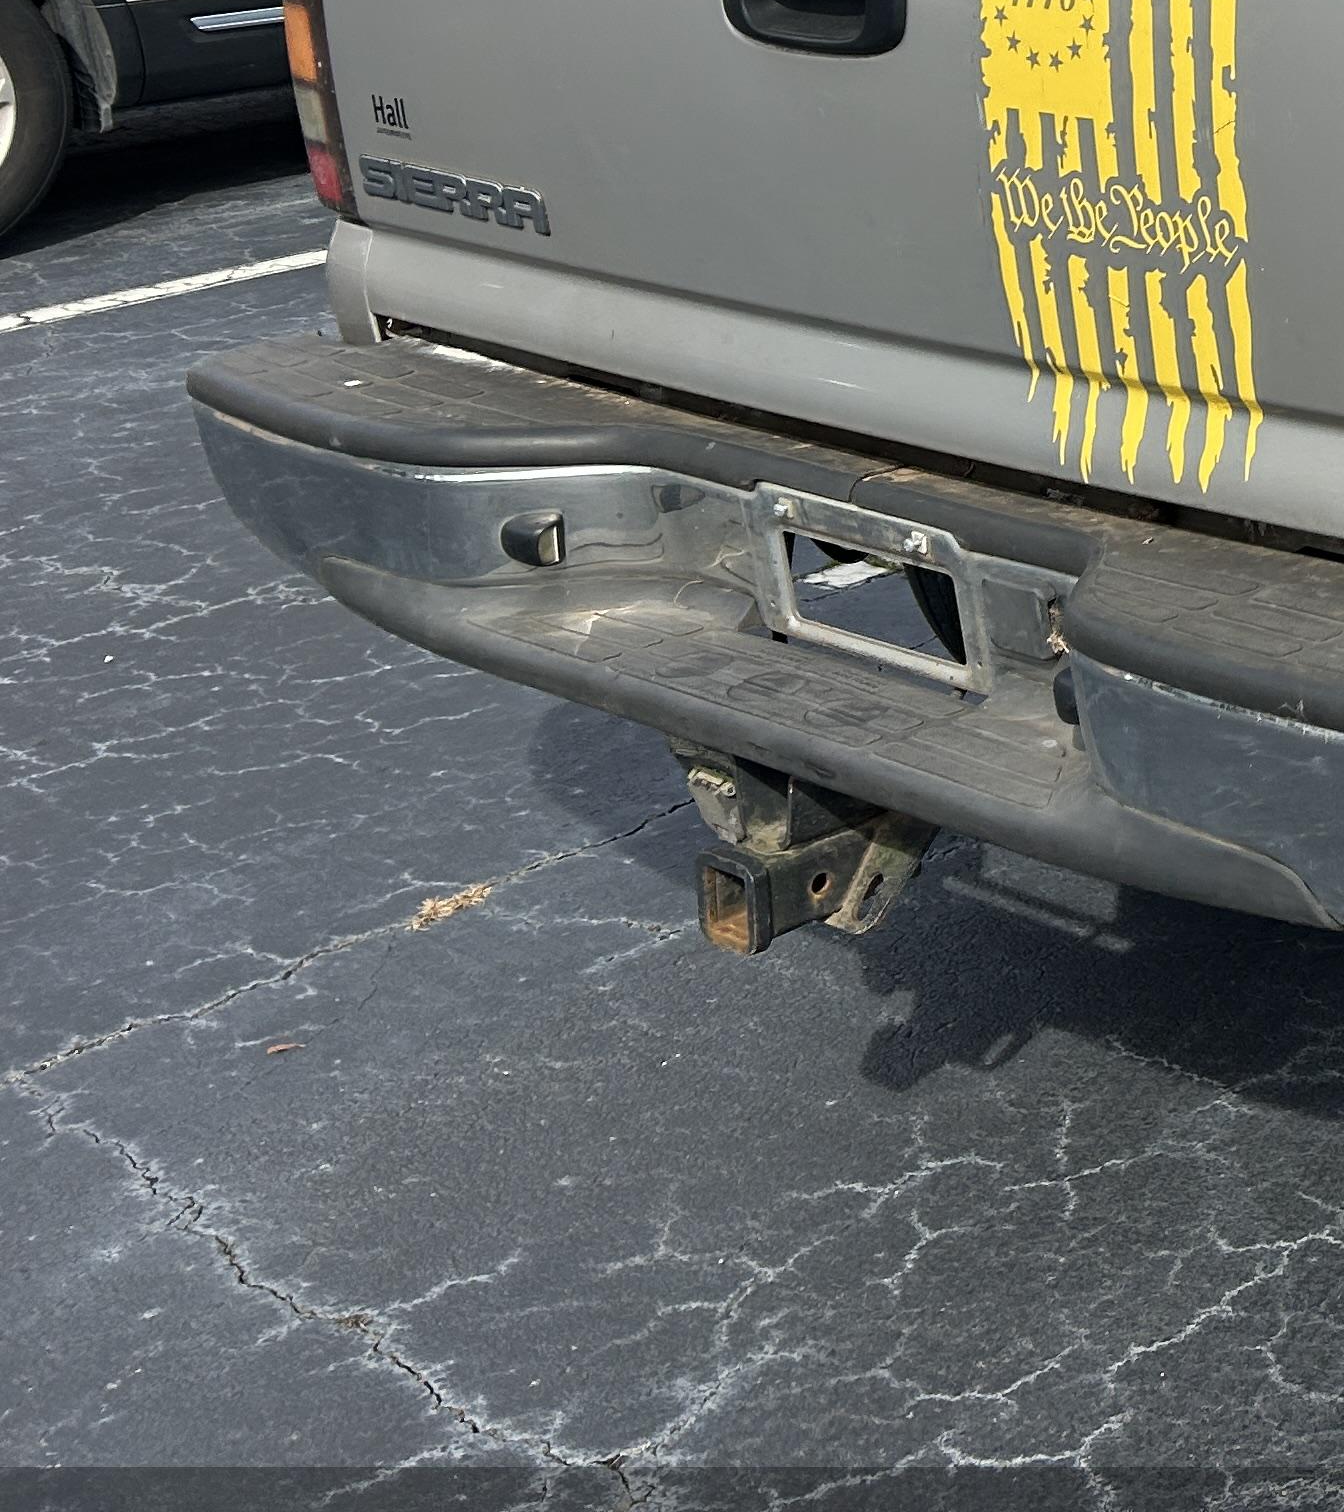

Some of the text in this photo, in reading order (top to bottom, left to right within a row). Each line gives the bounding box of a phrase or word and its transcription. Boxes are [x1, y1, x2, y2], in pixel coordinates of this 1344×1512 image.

[371, 94, 409, 130] Hall
[358, 153, 552, 237] SIERRA
[996, 167, 1239, 275] We the People
